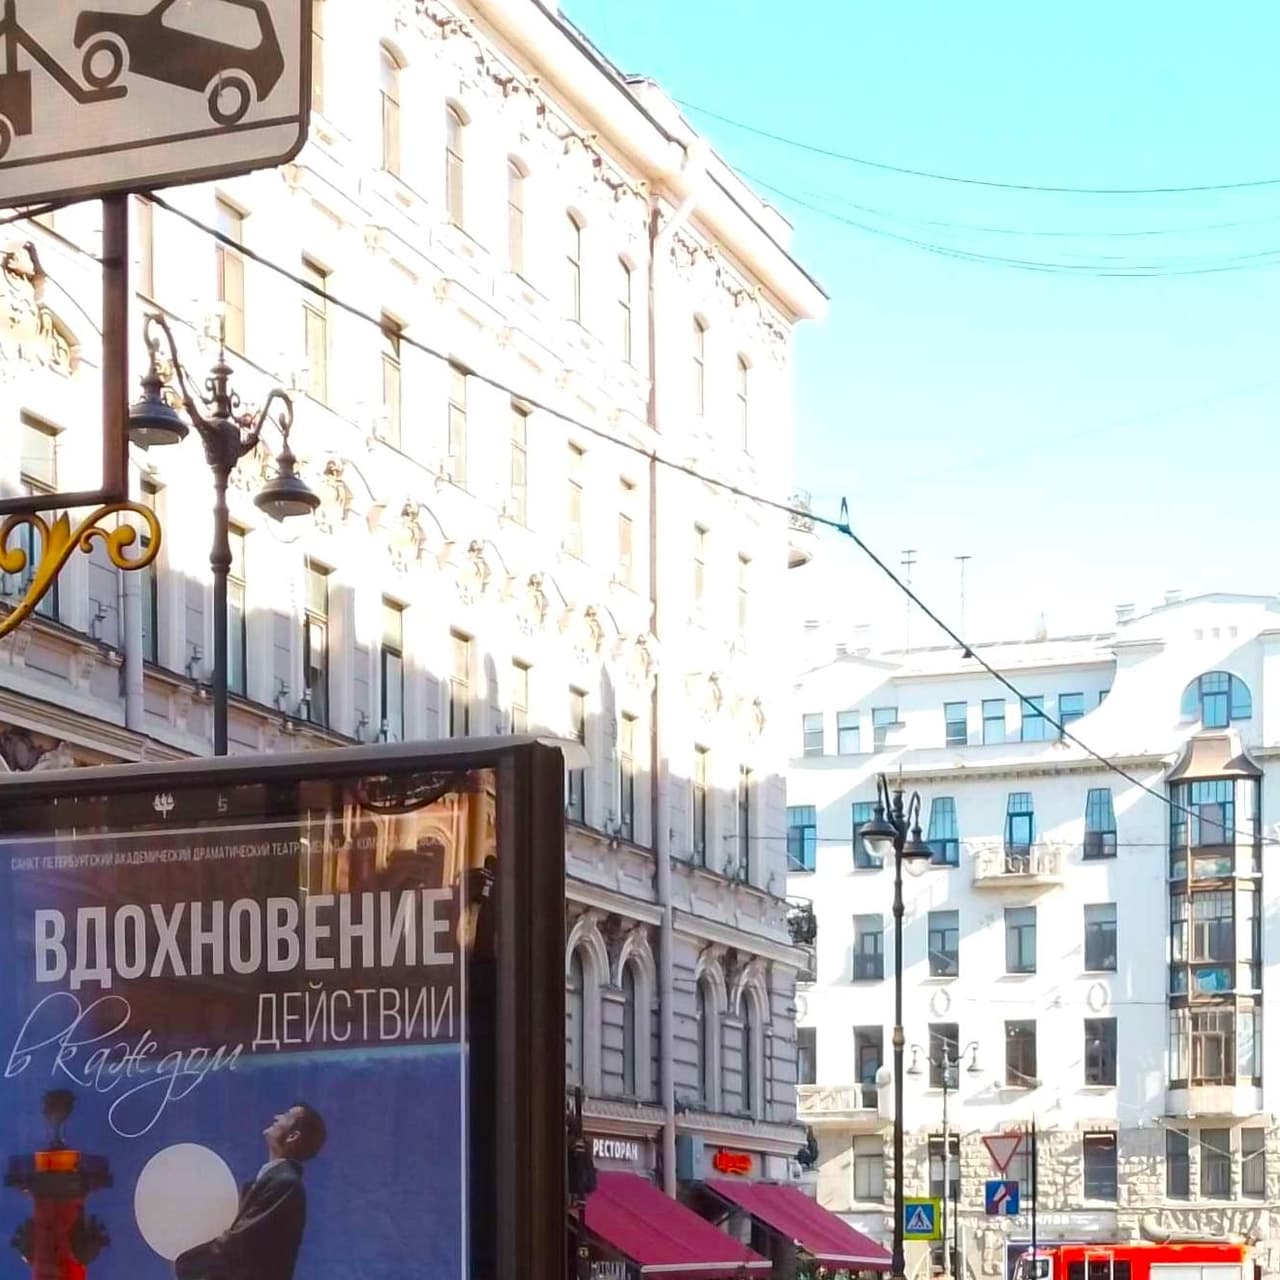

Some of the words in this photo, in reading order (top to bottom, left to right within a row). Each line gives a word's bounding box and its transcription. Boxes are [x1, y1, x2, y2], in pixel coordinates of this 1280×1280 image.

[35, 887, 455, 990] ВДОХНОВЕНИЕ
[252, 981, 455, 1052] ДЕЙСТВИИ
[593, 1139, 638, 1160] РЕСТОРАН
